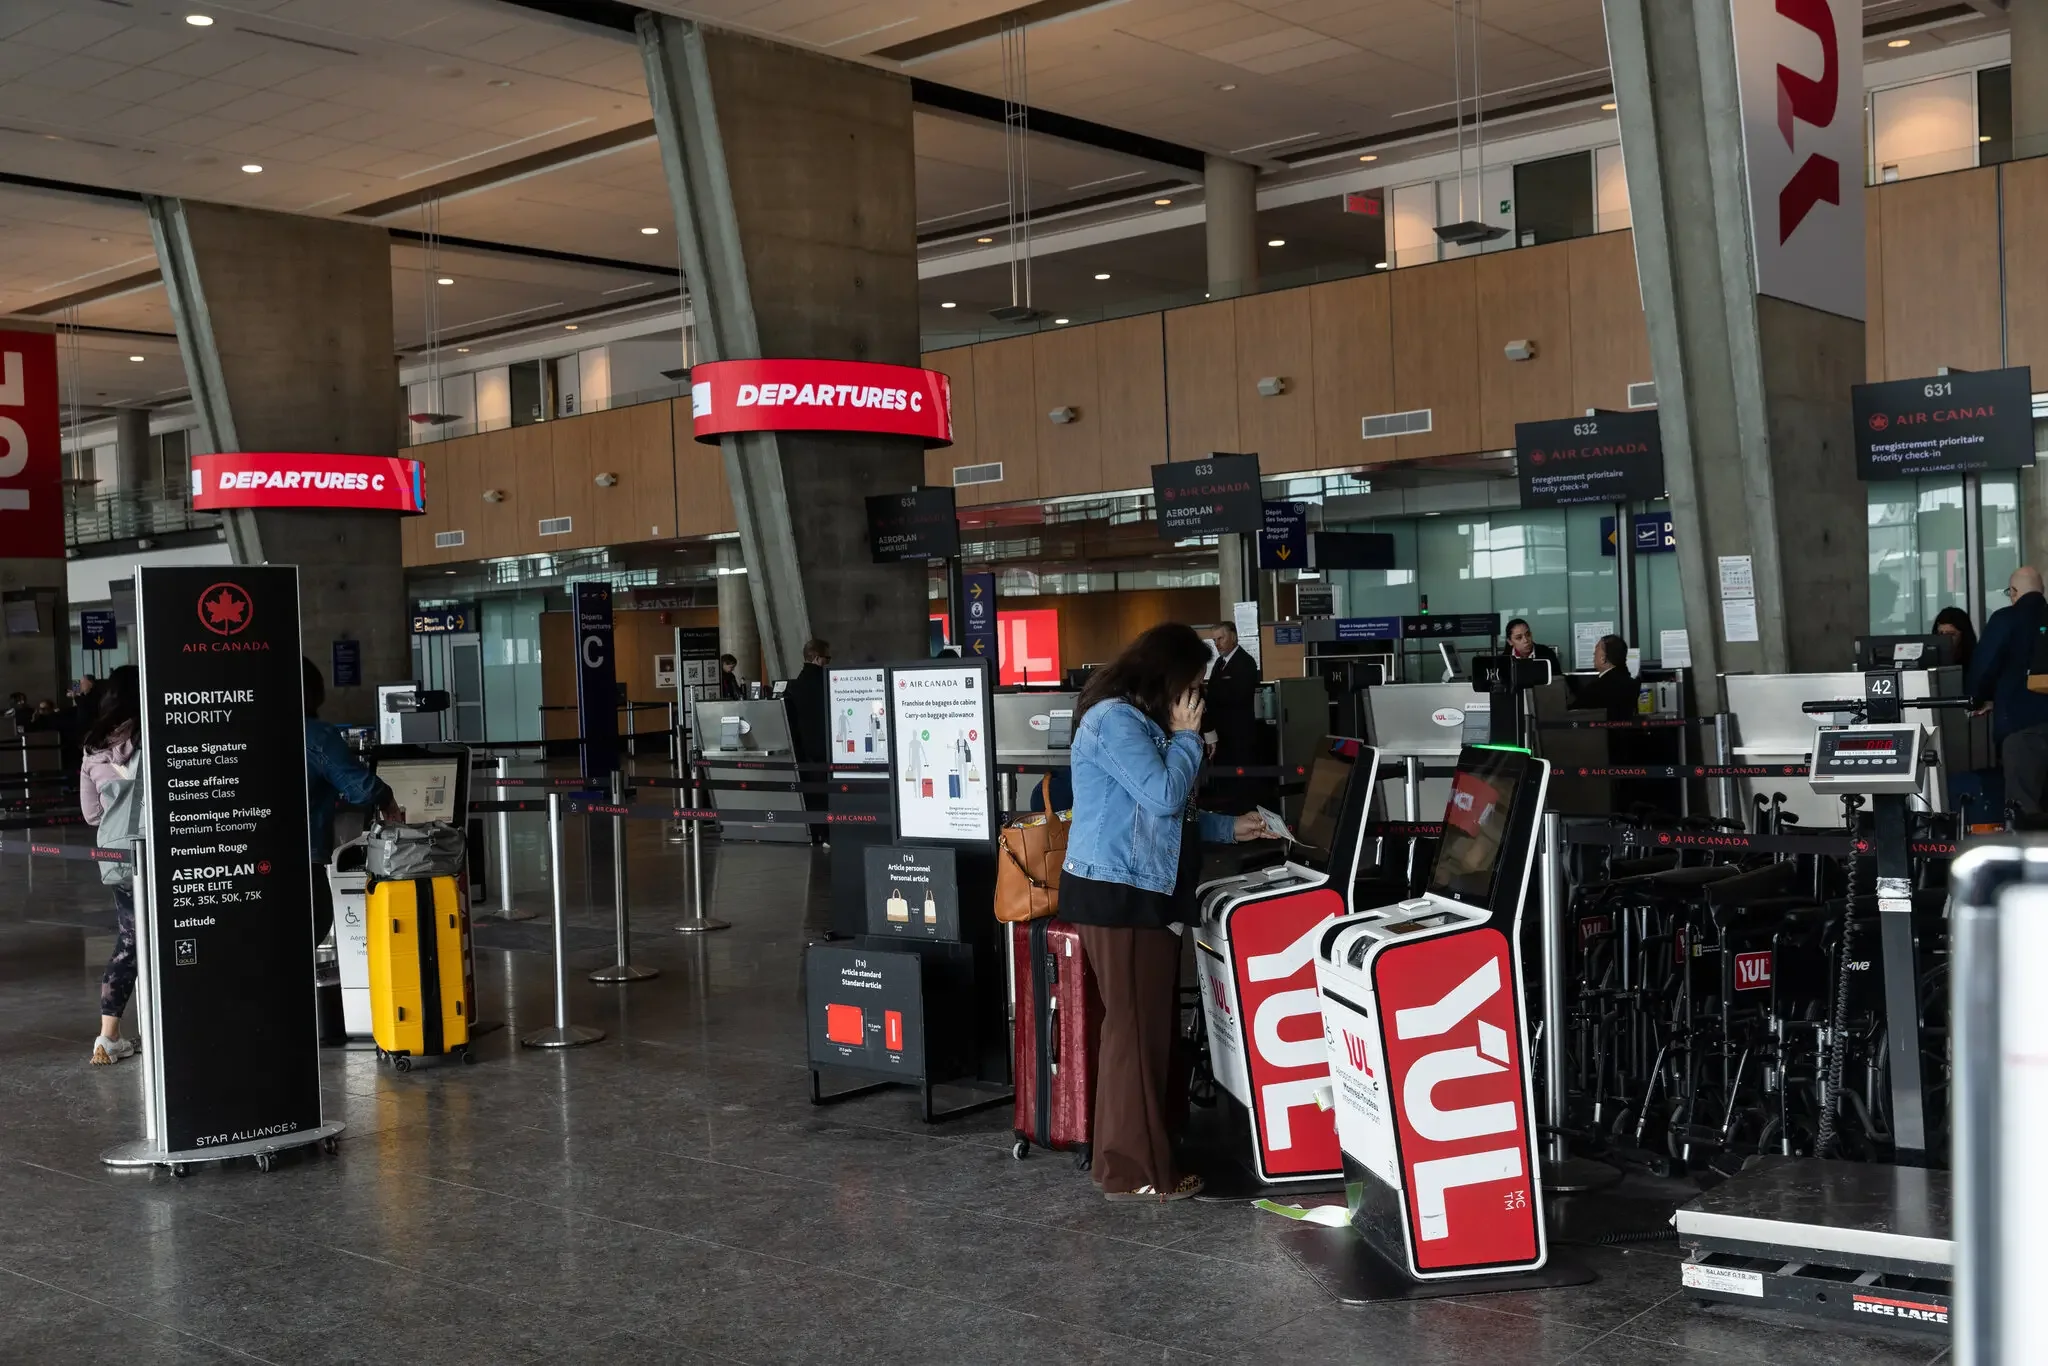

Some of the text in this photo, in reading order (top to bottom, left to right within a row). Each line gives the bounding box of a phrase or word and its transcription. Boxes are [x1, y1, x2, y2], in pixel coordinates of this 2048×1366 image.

[1924, 382, 1952, 397] 631
[736, 383, 922, 412] DEPARTURES C
[1897, 412, 1928, 425] AIR
[1574, 423, 1598, 436] 632
[1871, 435, 1985, 453] Enregistrement prioritaire
[1551, 442, 1648, 461] AIR CANADA
[1872, 449, 1941, 463] Priority check-in
[1195, 464, 1213, 476] 633
[219, 470, 385, 491] DEPARTURES C
[1531, 470, 1624, 485] Enregistrement prioritaire
[1180, 482, 1250, 497] AIR CANADA
[1532, 483, 1589, 494] Priority check-in
[901, 497, 916, 507] 634
[1166, 505, 1213, 518] AEROPLAN
[1167, 519, 1185, 527] SUPER
[879, 534, 917, 544] AEROPLAN
[447, 615, 454, 630] C
[182, 641, 270, 652] AIR CANADA
[583, 634, 604, 668] C
[909, 679, 958, 688] AIR CANADA
[1872, 680, 1891, 694] 42
[164, 690, 254, 706] PRIORITAIRE
[932, 700, 952, 708] bagages
[165, 709, 232, 725] PRIORITY
[905, 712, 927, 720] Carry-on
[927, 711, 948, 720] baggage
[166, 742, 247, 755] Classe Signature
[167, 754, 239, 769] Signature Class
[1725, 767, 1767, 775] CANADA
[168, 776, 239, 788] Classe affaires
[168, 789, 236, 802] Business Class
[169, 806, 272, 823] Économique Privilège
[170, 822, 257, 836] Premium Economy
[1407, 825, 1442, 833] CANAD
[1674, 836, 1749, 847] AIR CANADA
[171, 843, 248, 857] Premium Rouge
[903, 855, 914, 863] (1x)
[172, 863, 255, 881] AEROPLAN
[888, 864, 931, 873] Article personnel
[890, 874, 929, 883] Personal article
[172, 881, 233, 894] SUPER ELITE
[173, 891, 262, 908] 25K, 35K, 50K, 75K
[174, 916, 216, 929] Latitude
[855, 959, 866, 969] (1x)
[1738, 957, 1771, 984] YUL
[841, 968, 882, 979] Article standard
[842, 979, 882, 990] Standard article
[1209, 975, 1231, 1015] YUL
[1342, 1028, 1374, 1078] YUL
[1396, 956, 1523, 1242] YUL
[196, 1123, 289, 1147] STAR ALLIANCE
[1503, 1191, 1514, 1211] TM
[1514, 1190, 1525, 1208] MC
[1853, 1302, 1949, 1324] RICE LAKE
